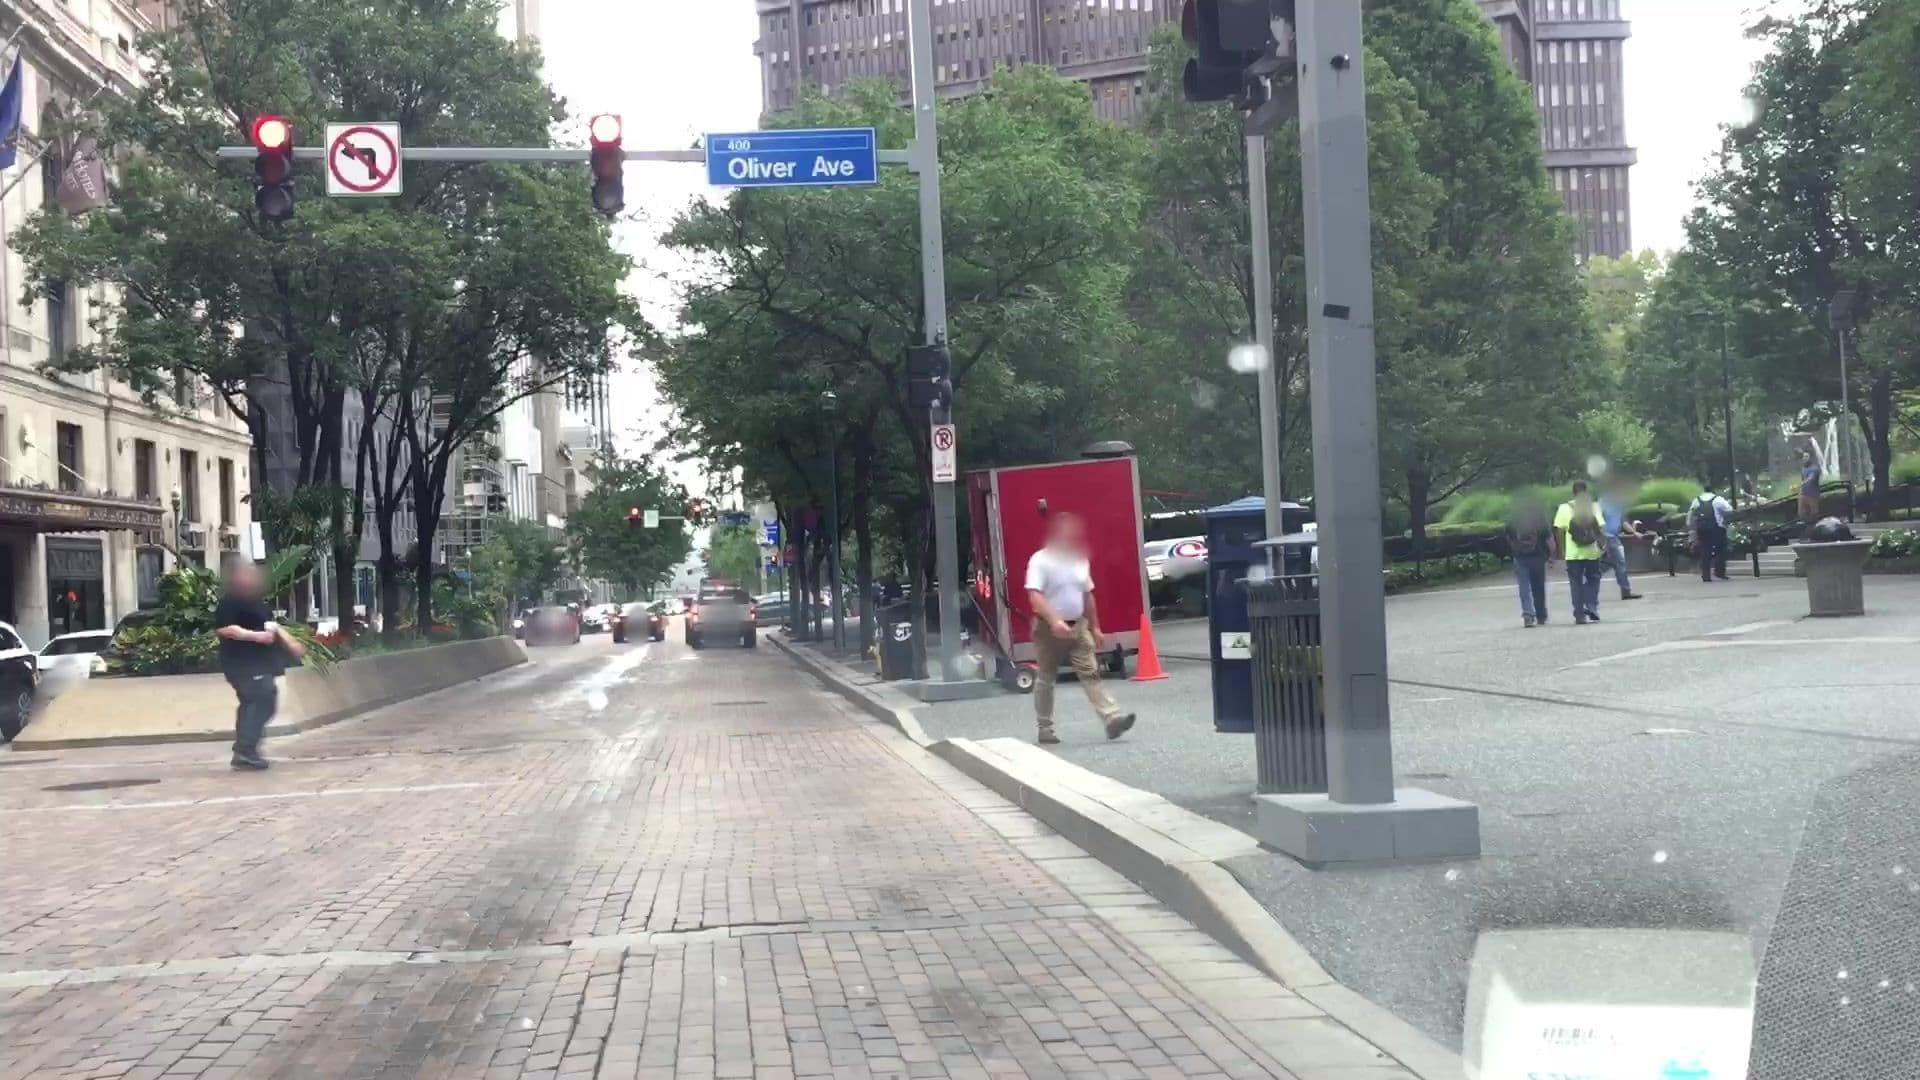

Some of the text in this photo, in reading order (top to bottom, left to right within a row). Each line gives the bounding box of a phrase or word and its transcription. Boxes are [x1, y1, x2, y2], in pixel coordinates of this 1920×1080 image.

[728, 140, 751, 151] 400
[728, 155, 856, 180] Oliver Ave
